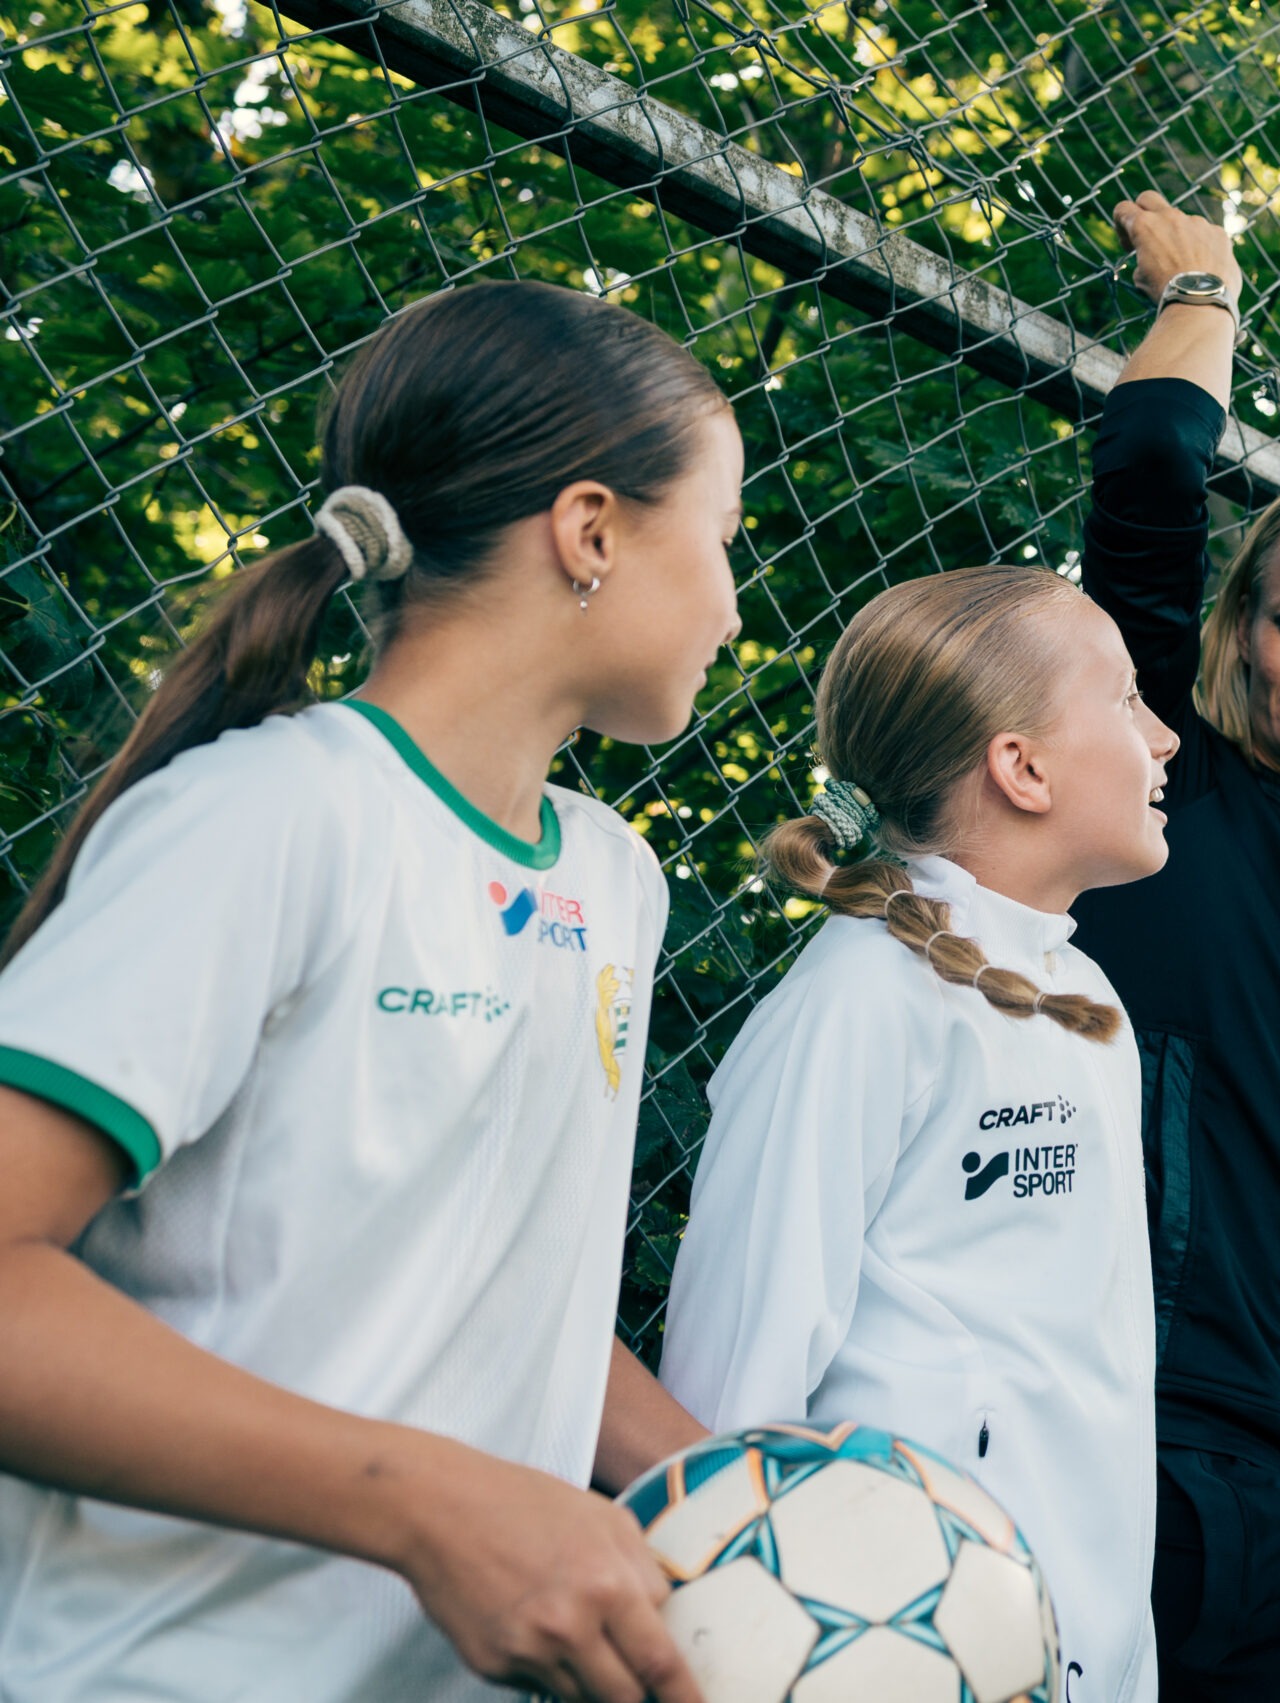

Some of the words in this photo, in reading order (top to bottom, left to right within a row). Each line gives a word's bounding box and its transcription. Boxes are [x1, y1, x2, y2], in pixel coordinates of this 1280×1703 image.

[538, 889, 584, 924] TER
[538, 919, 587, 951] PORT
[377, 987, 482, 1016] CRAFT
[979, 1101, 1056, 1130] CRAFT
[1015, 1144, 1076, 1172] INTER
[1013, 1169, 1075, 1198] SPORT
